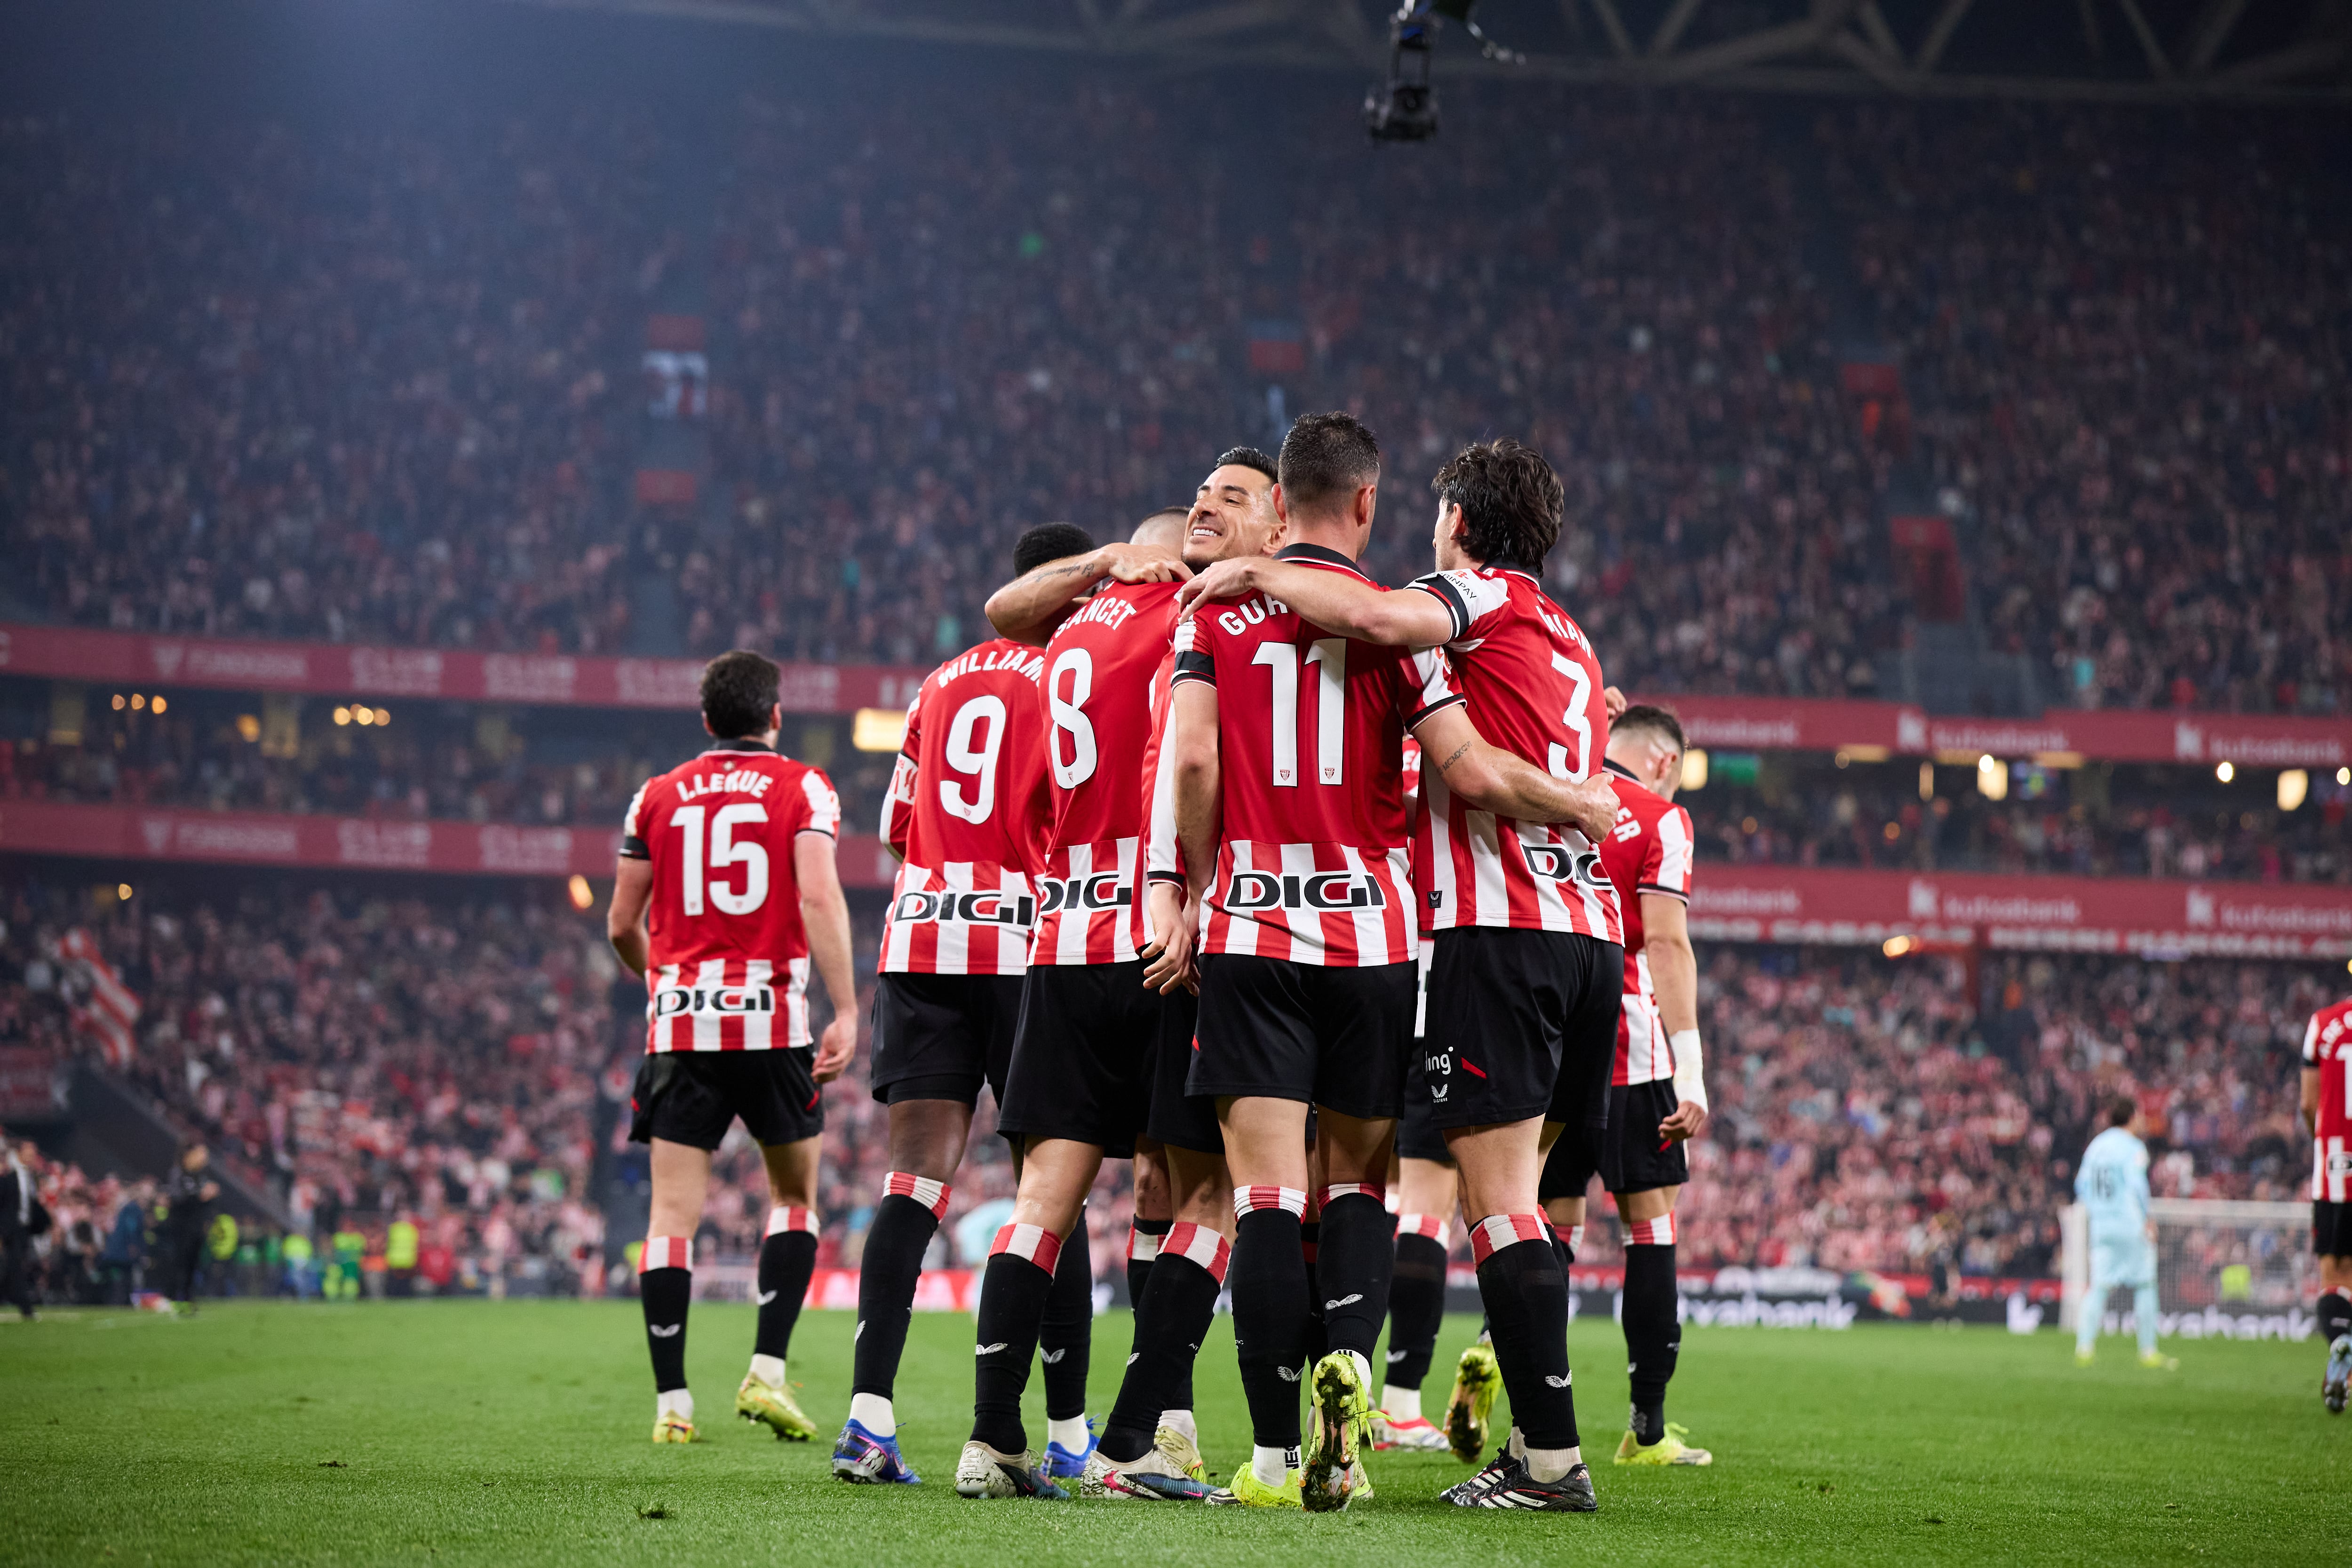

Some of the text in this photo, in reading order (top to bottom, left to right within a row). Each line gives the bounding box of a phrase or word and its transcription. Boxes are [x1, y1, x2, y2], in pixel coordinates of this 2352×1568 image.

[938, 649, 1045, 688] WILLIAM
[1049, 647, 1098, 790] 8
[1251, 637, 1347, 788] 11
[1548, 649, 1592, 785] 3
[940, 694, 1007, 825] 9
[669, 803, 769, 916] 15
[1040, 874, 1132, 912] DIG
[1228, 873, 1385, 908] DIGI
[894, 891, 1033, 926] DIGI
[658, 987, 771, 1015] DIGI
